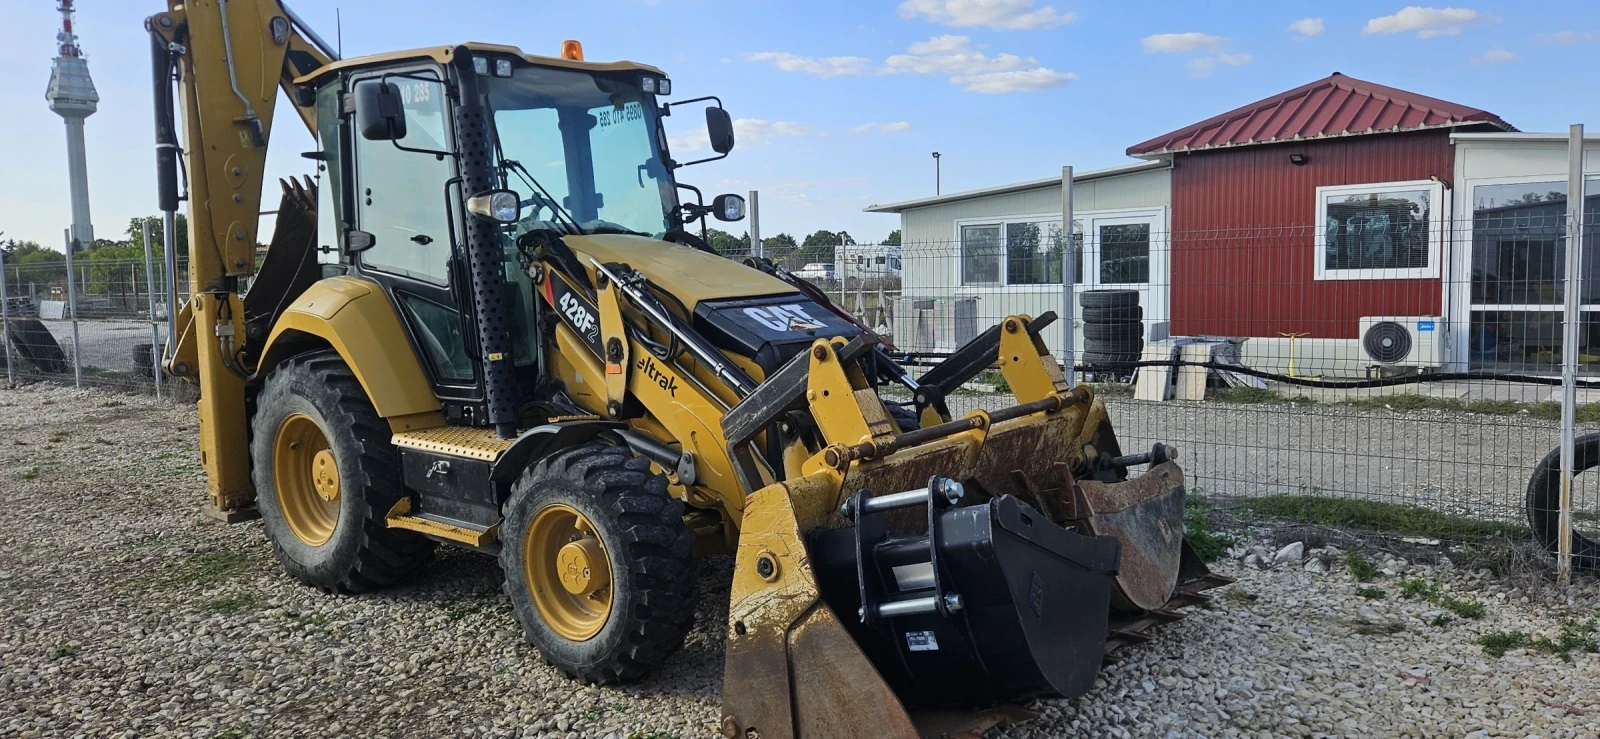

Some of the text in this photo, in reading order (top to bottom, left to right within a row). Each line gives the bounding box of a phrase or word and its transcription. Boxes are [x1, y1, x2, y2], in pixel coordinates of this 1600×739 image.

[414, 81, 430, 103] 285
[742, 303, 829, 332] CAT
[636, 356, 679, 398] eltrak
